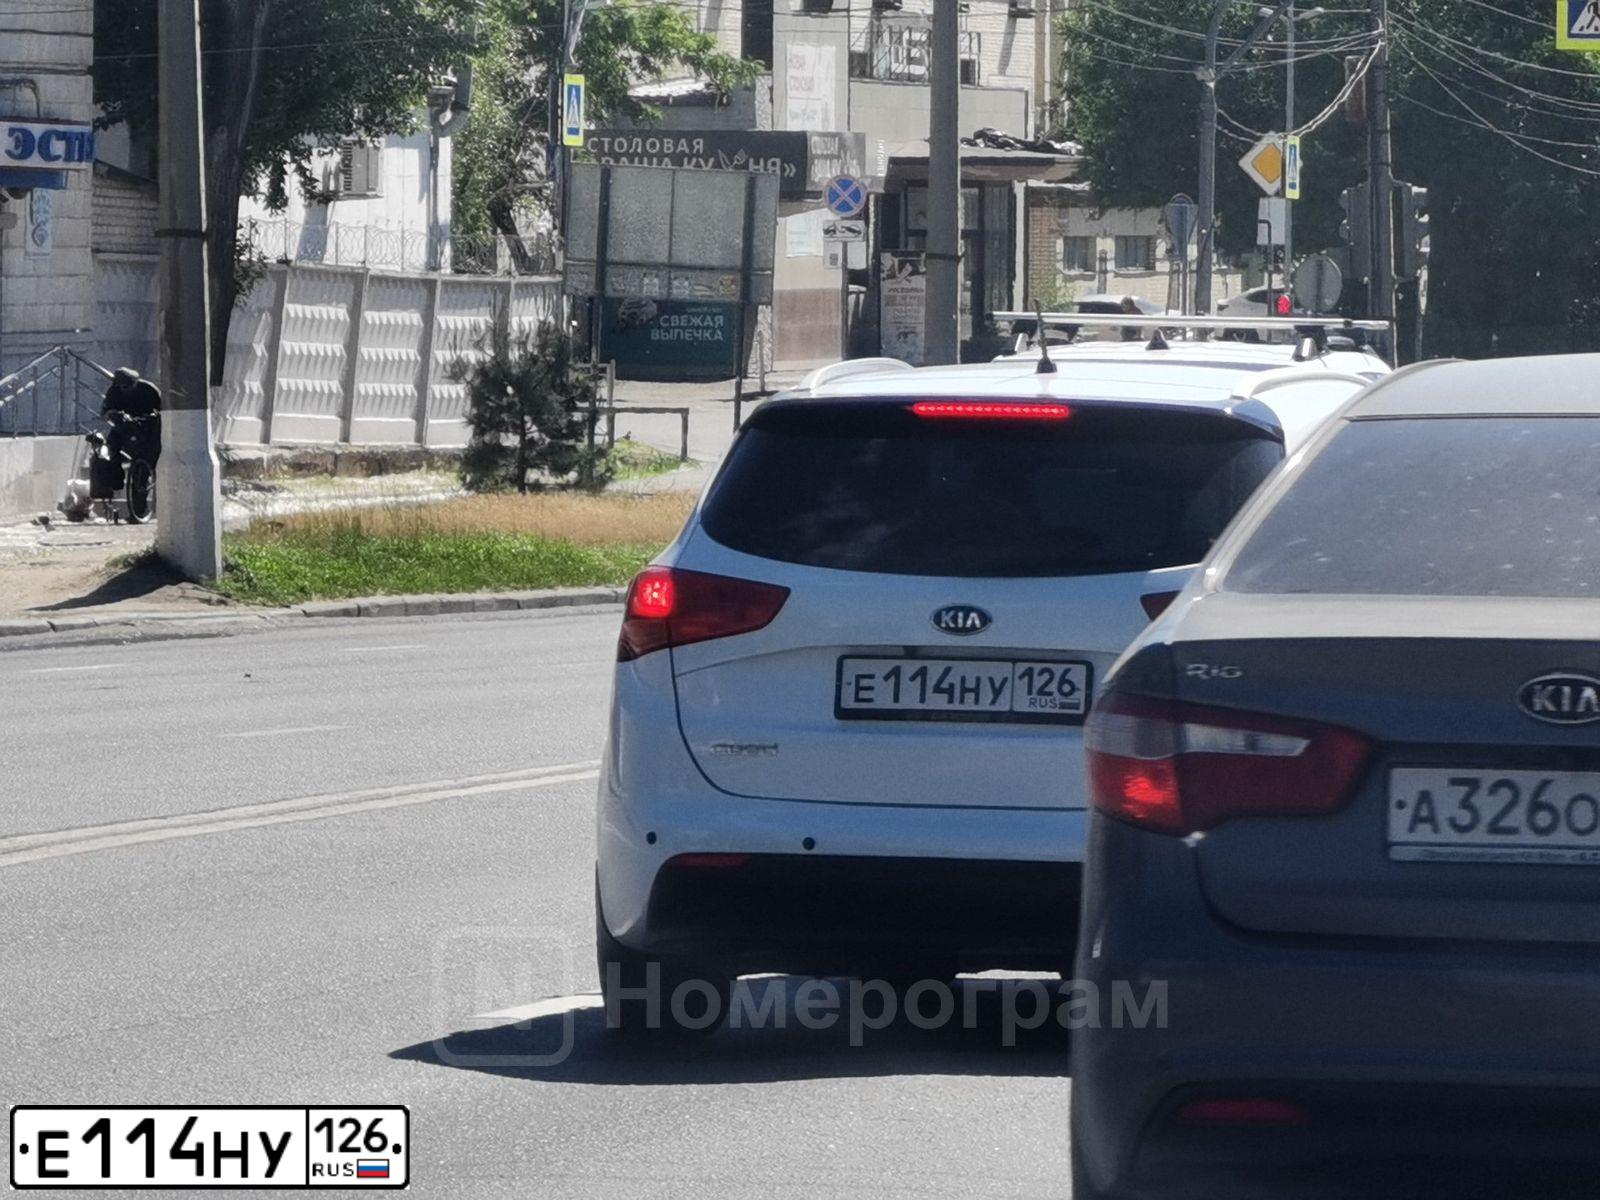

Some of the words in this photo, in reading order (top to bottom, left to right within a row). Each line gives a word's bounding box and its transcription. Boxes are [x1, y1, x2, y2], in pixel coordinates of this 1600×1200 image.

[586, 137, 704, 154] СТОЛОВАЯ
[660, 315, 724, 328] СВЕЖАЯ
[650, 328, 724, 341] ВЫПЕЧКА
[940, 610, 981, 628] KIA
[853, 665, 1009, 706] Е114НУ
[1017, 666, 1076, 697] 126
[1028, 697, 1058, 709] RUS
[1532, 684, 1600, 713] KIA
